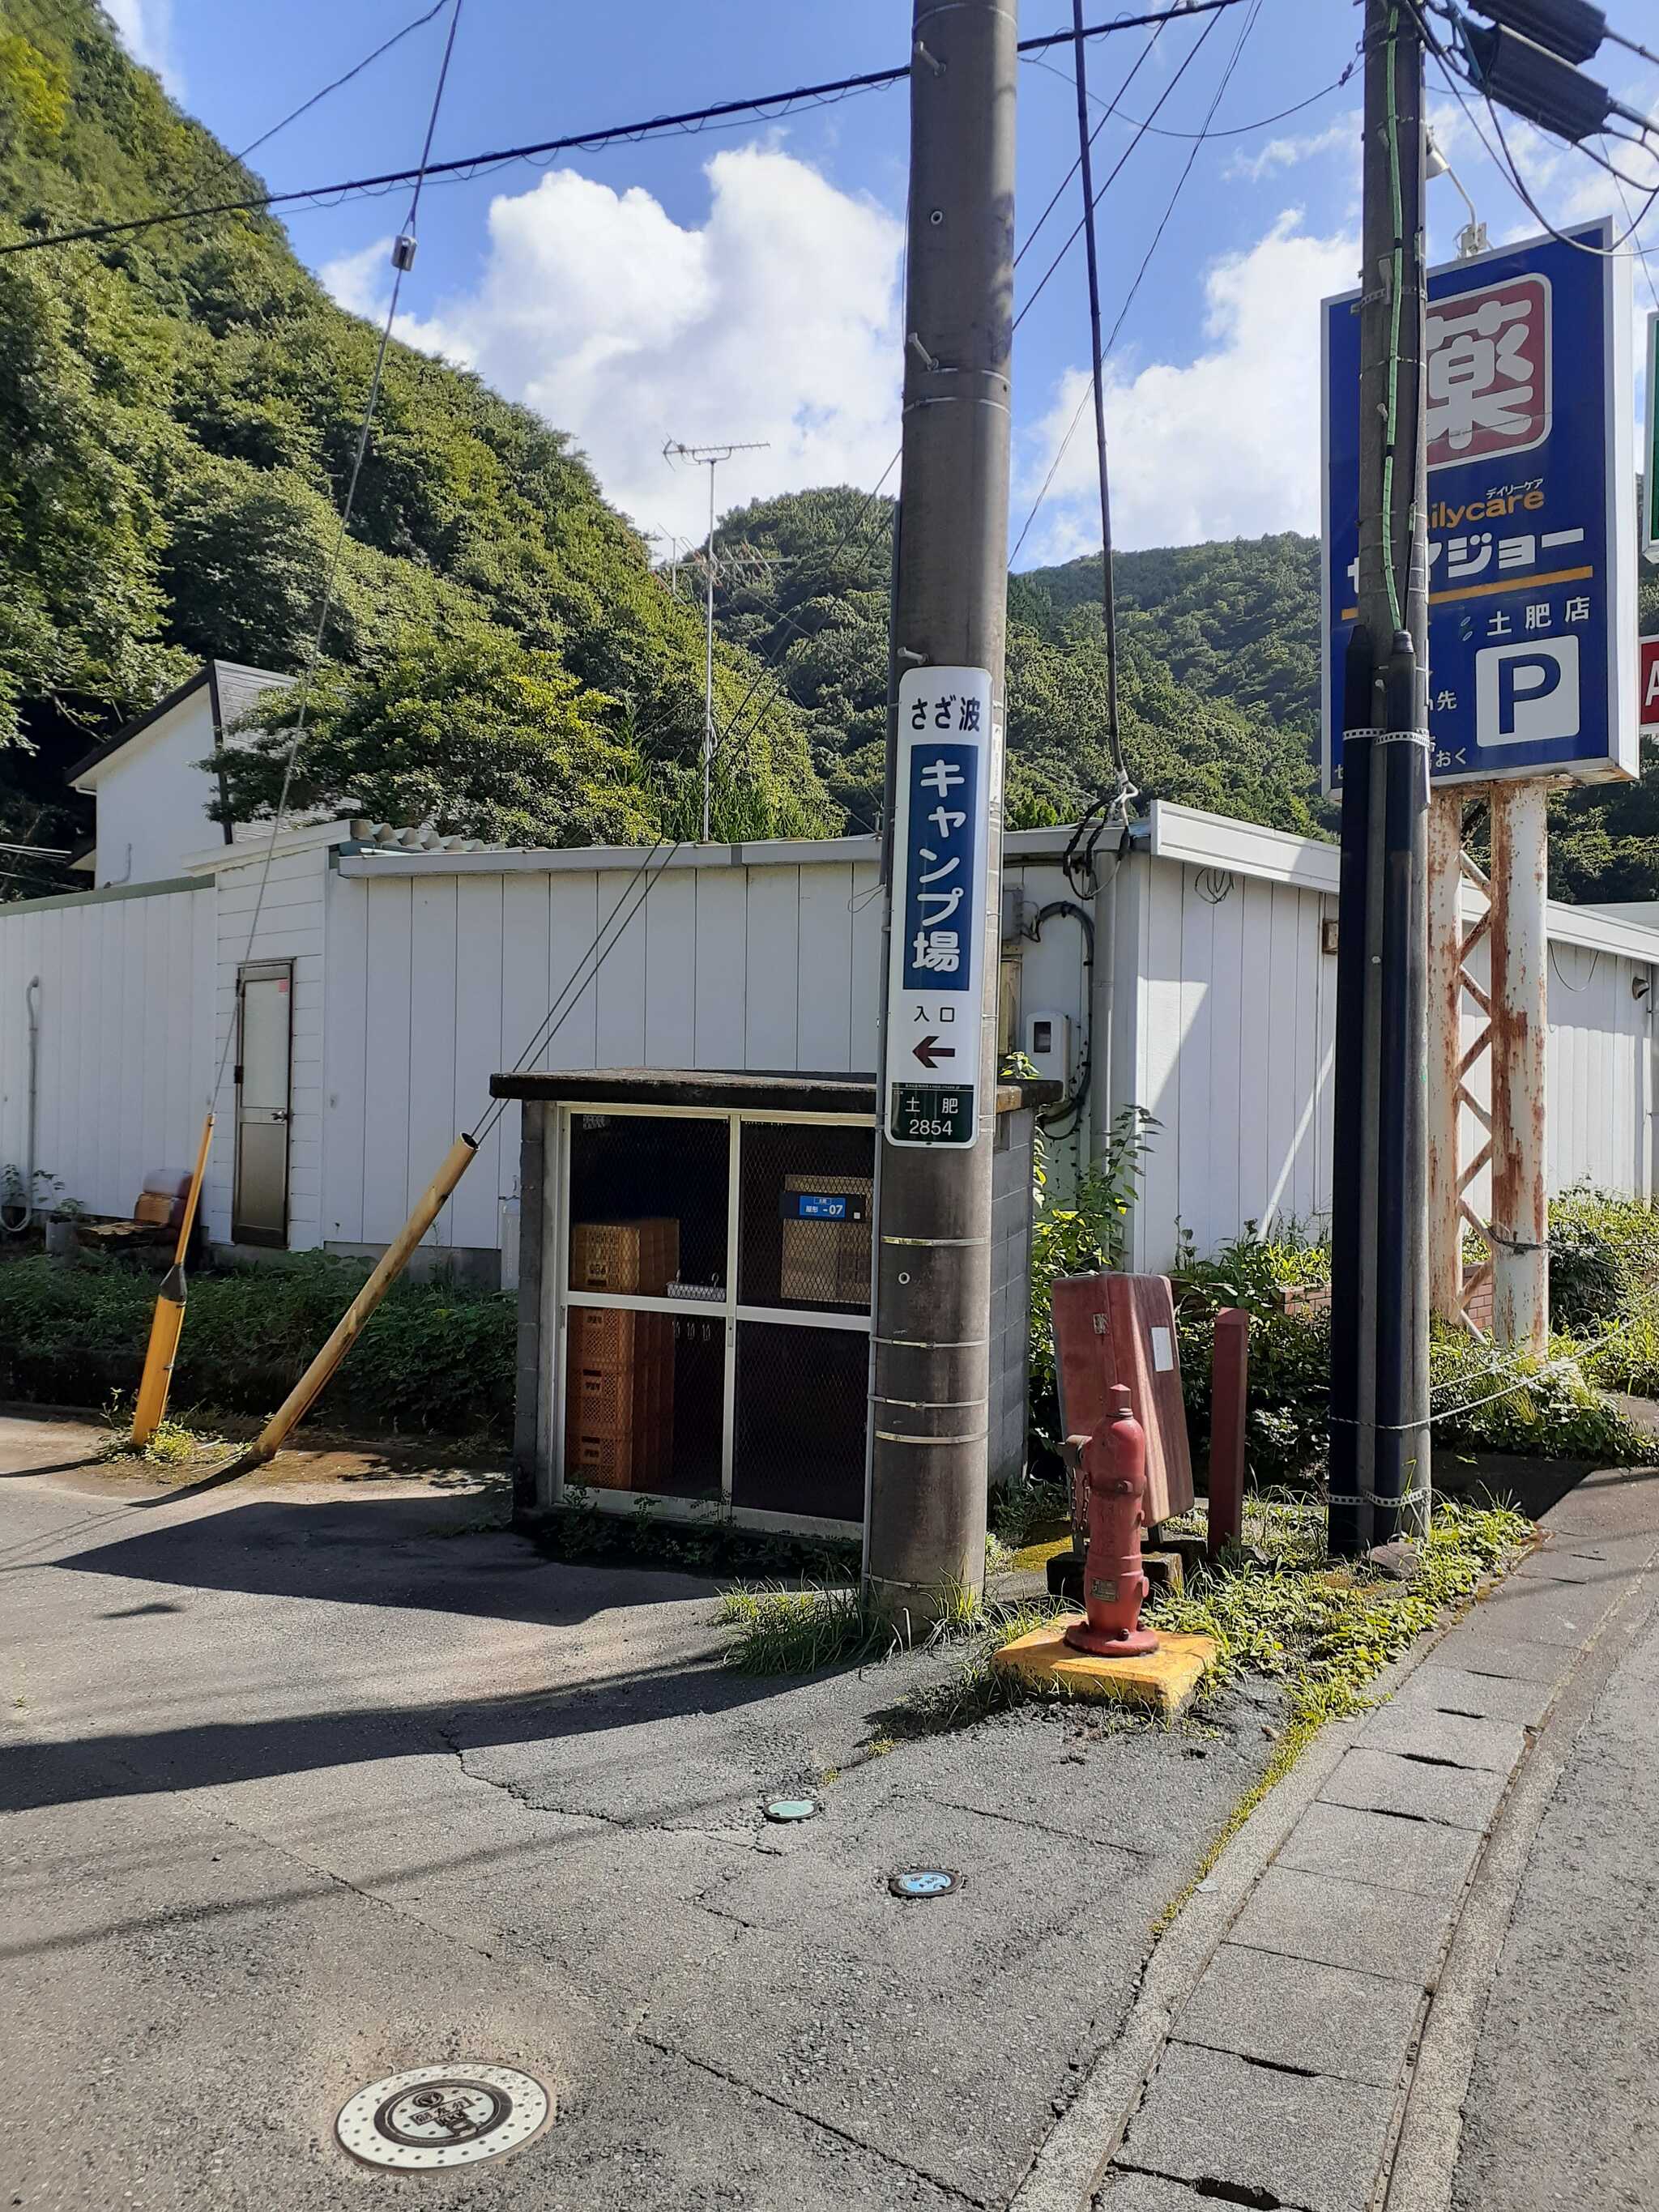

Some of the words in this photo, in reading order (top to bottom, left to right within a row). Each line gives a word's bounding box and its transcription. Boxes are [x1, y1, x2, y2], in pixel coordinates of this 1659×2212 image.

[1427, 299, 1534, 450] 薬
[1427, 491, 1545, 529] ilycare
[1486, 596, 1590, 637] 土肥店
[912, 694, 981, 732] さざ波
[1499, 653, 1562, 735] P
[912, 759, 966, 972] キャンプ場
[913, 1005, 955, 1022] 入口
[905, 1096, 959, 1115] 土肥
[909, 1119, 953, 1136] 2854
